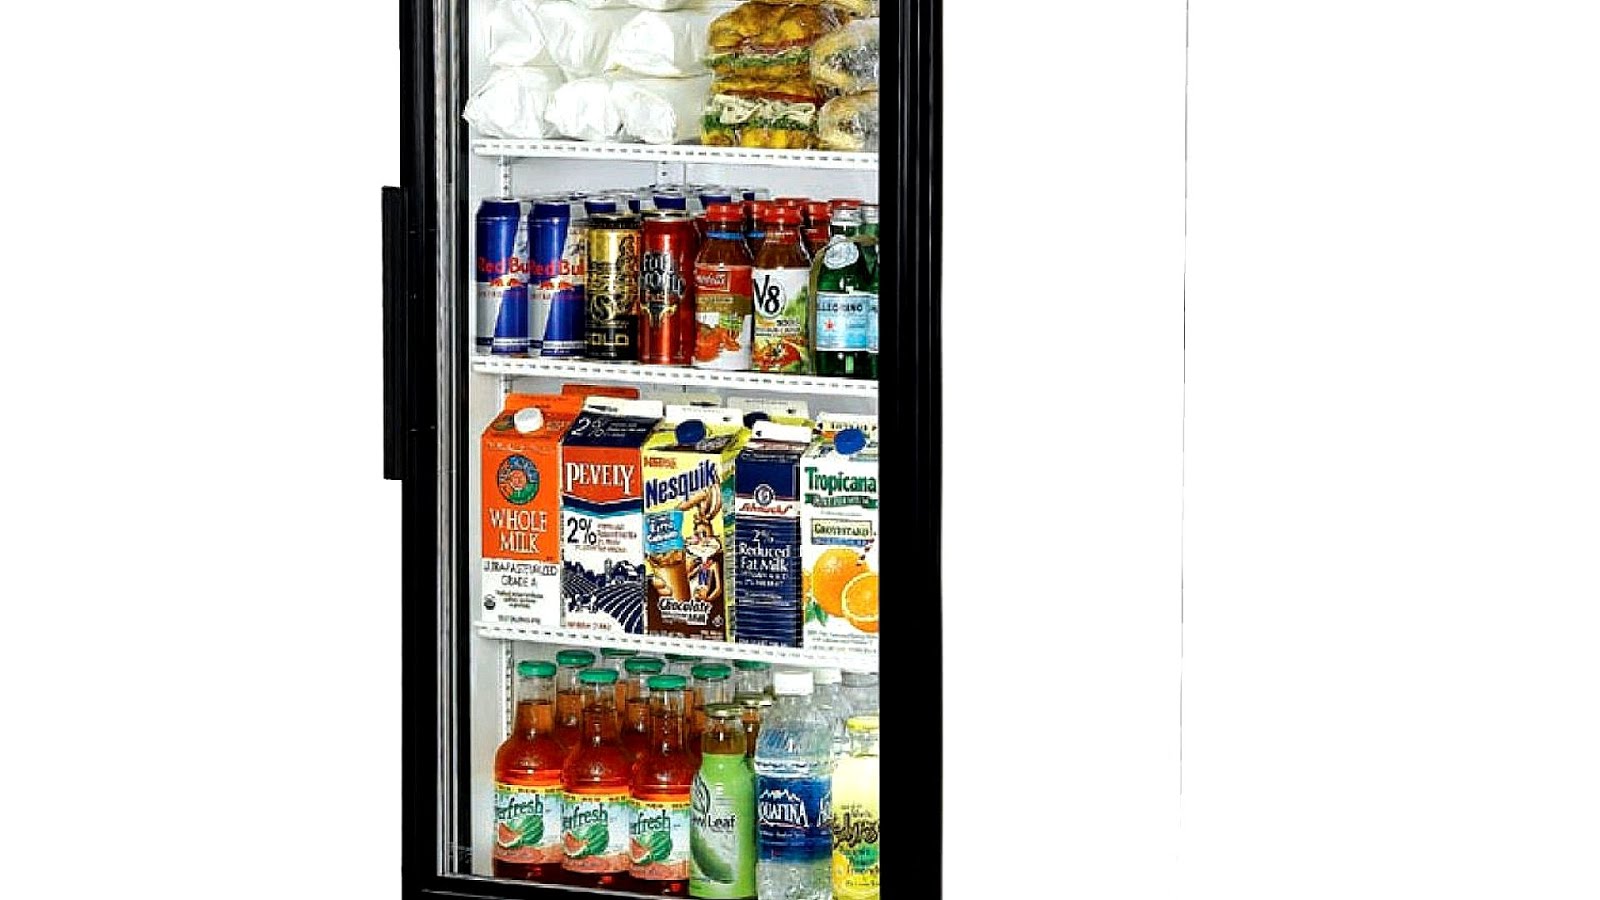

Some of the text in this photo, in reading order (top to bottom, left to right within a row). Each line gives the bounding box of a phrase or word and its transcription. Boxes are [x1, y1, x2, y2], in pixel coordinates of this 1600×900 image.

[754, 274, 781, 315] V8
[586, 332, 630, 346] OLD
[565, 462, 635, 495] PEVELY
[645, 459, 717, 509] Nesquik
[804, 466, 877, 495] Tropicana
[489, 508, 549, 532] WHOLE
[567, 517, 597, 545] 2%
[499, 531, 541, 553] MILK
[738, 542, 791, 558] Reduced
[741, 556, 789, 573] Fat Milk
[707, 813, 736, 828] Leaf
